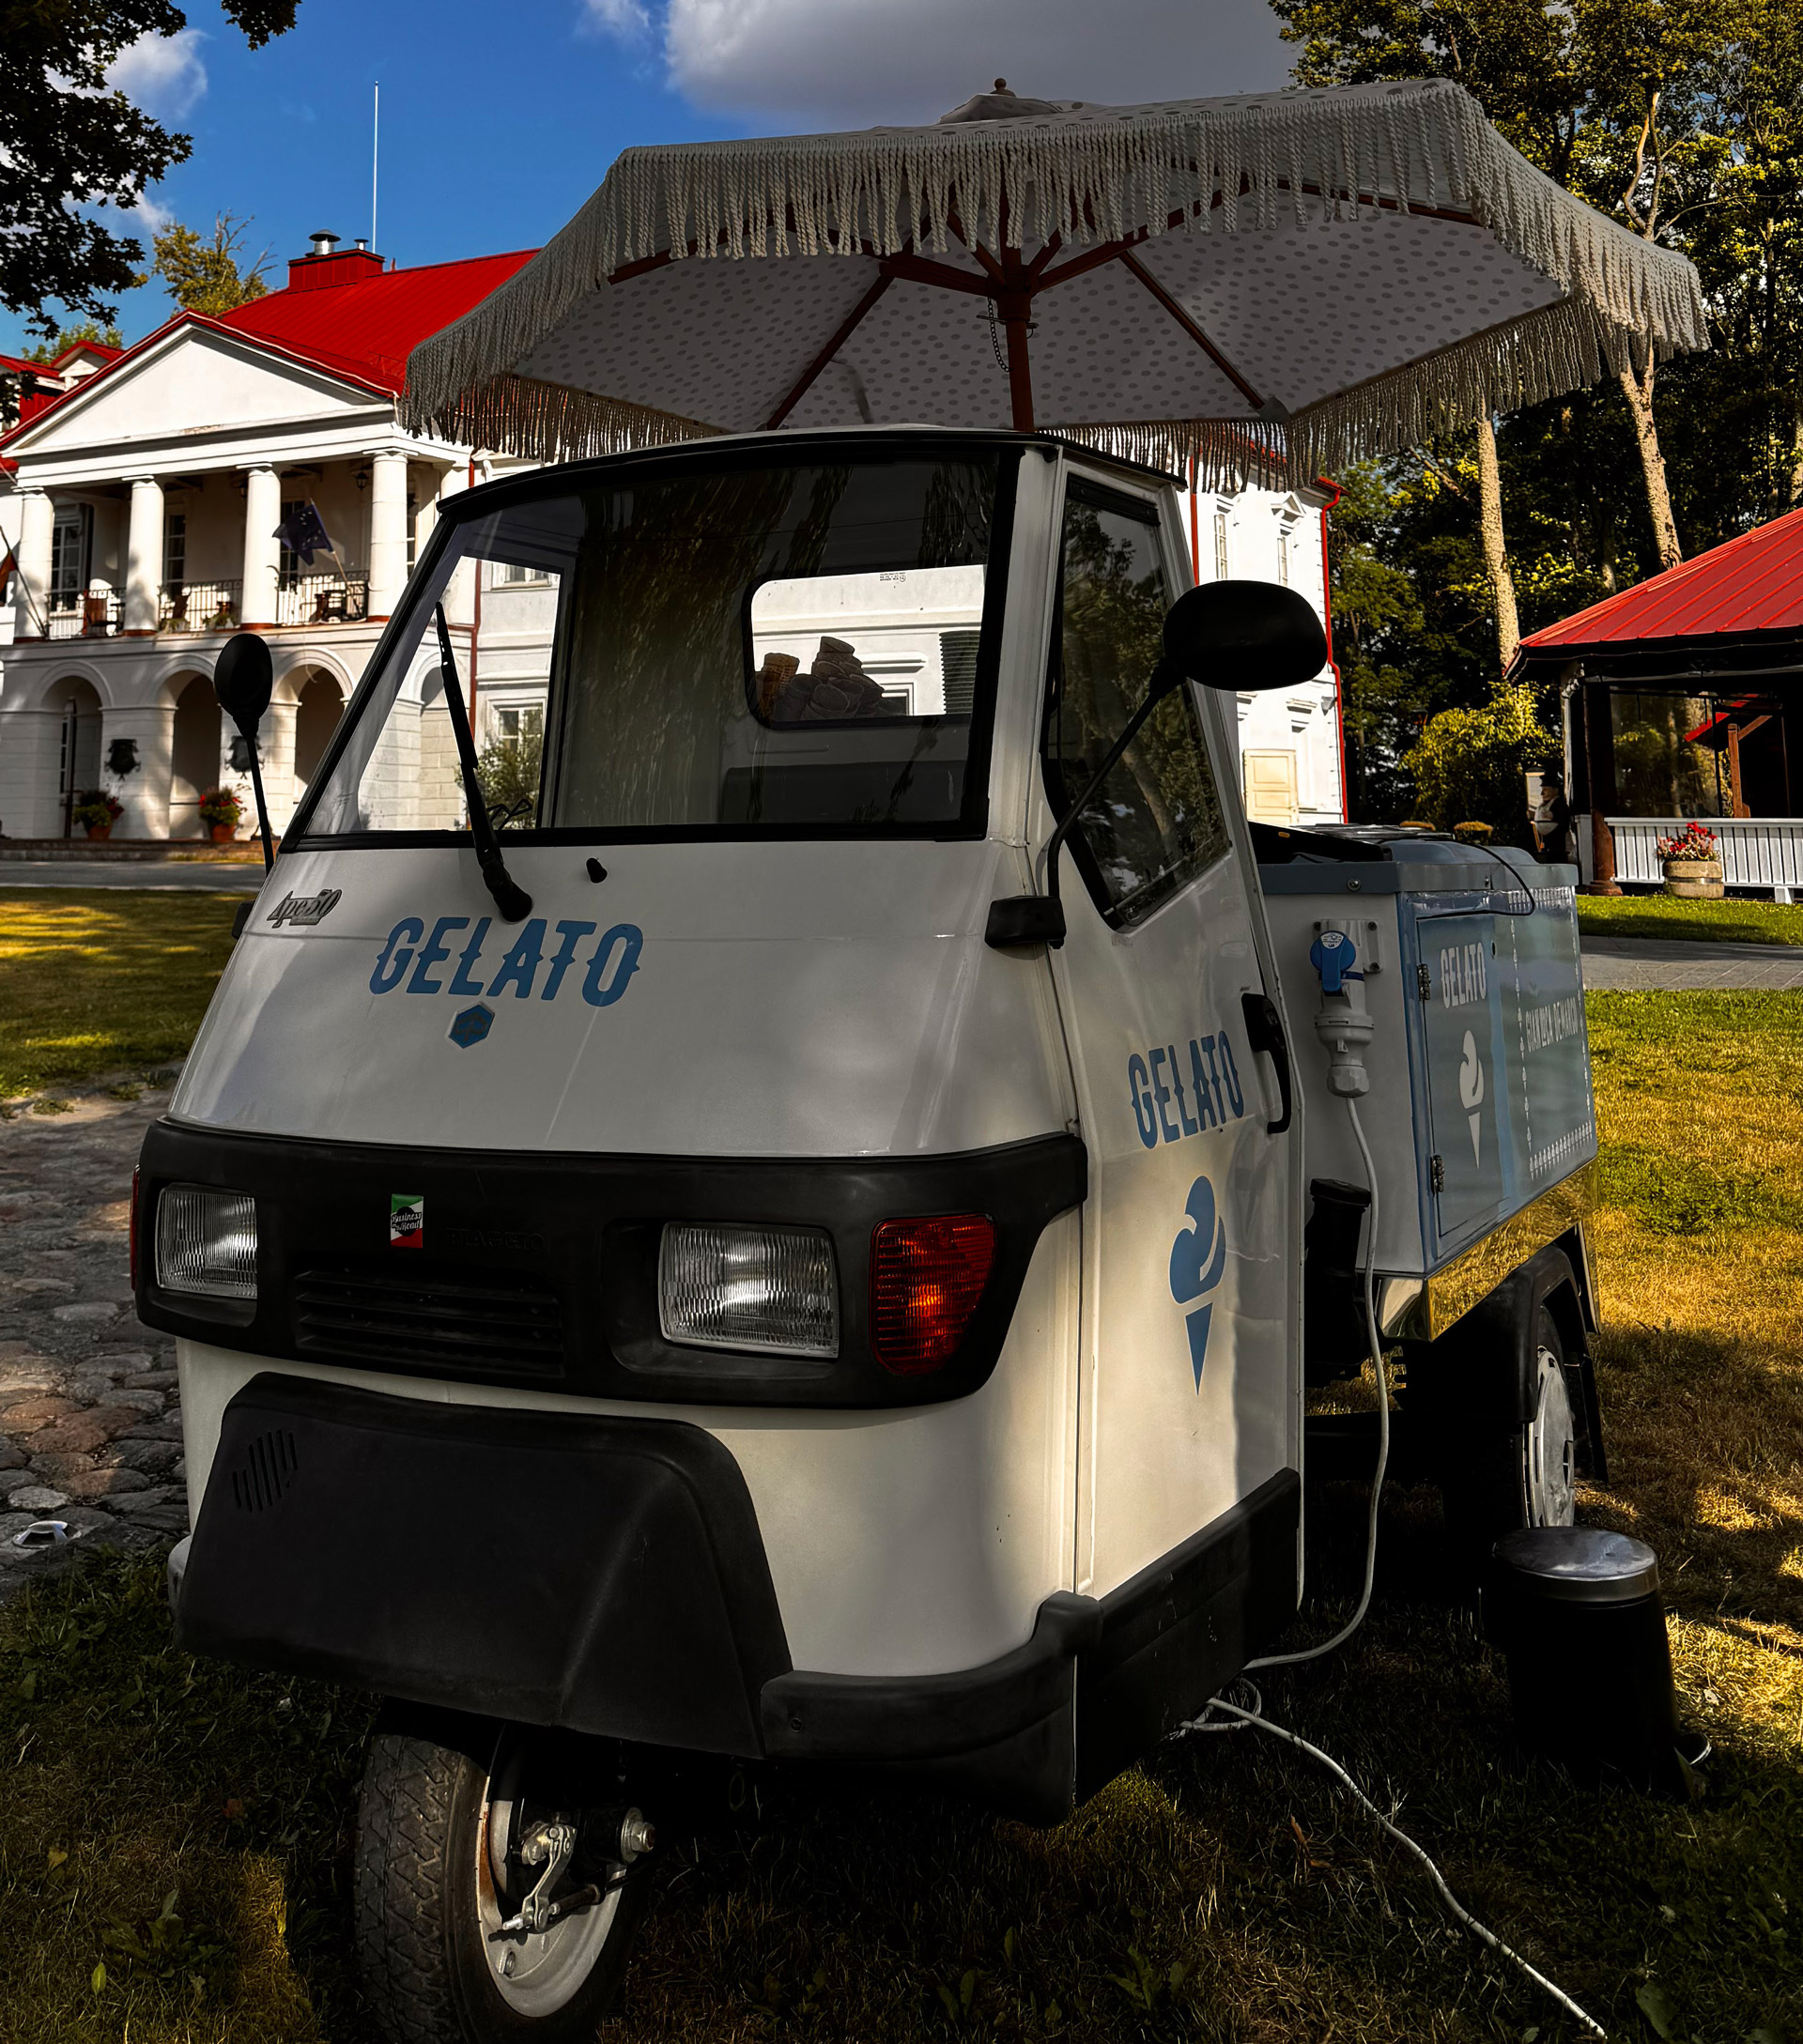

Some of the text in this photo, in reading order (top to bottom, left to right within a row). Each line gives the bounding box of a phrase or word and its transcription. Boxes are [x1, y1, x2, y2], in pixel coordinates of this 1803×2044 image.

[369, 916, 644, 1007] GELATO
[1440, 942, 1487, 1008] GELATO
[1128, 1030, 1245, 1149] GELATO
